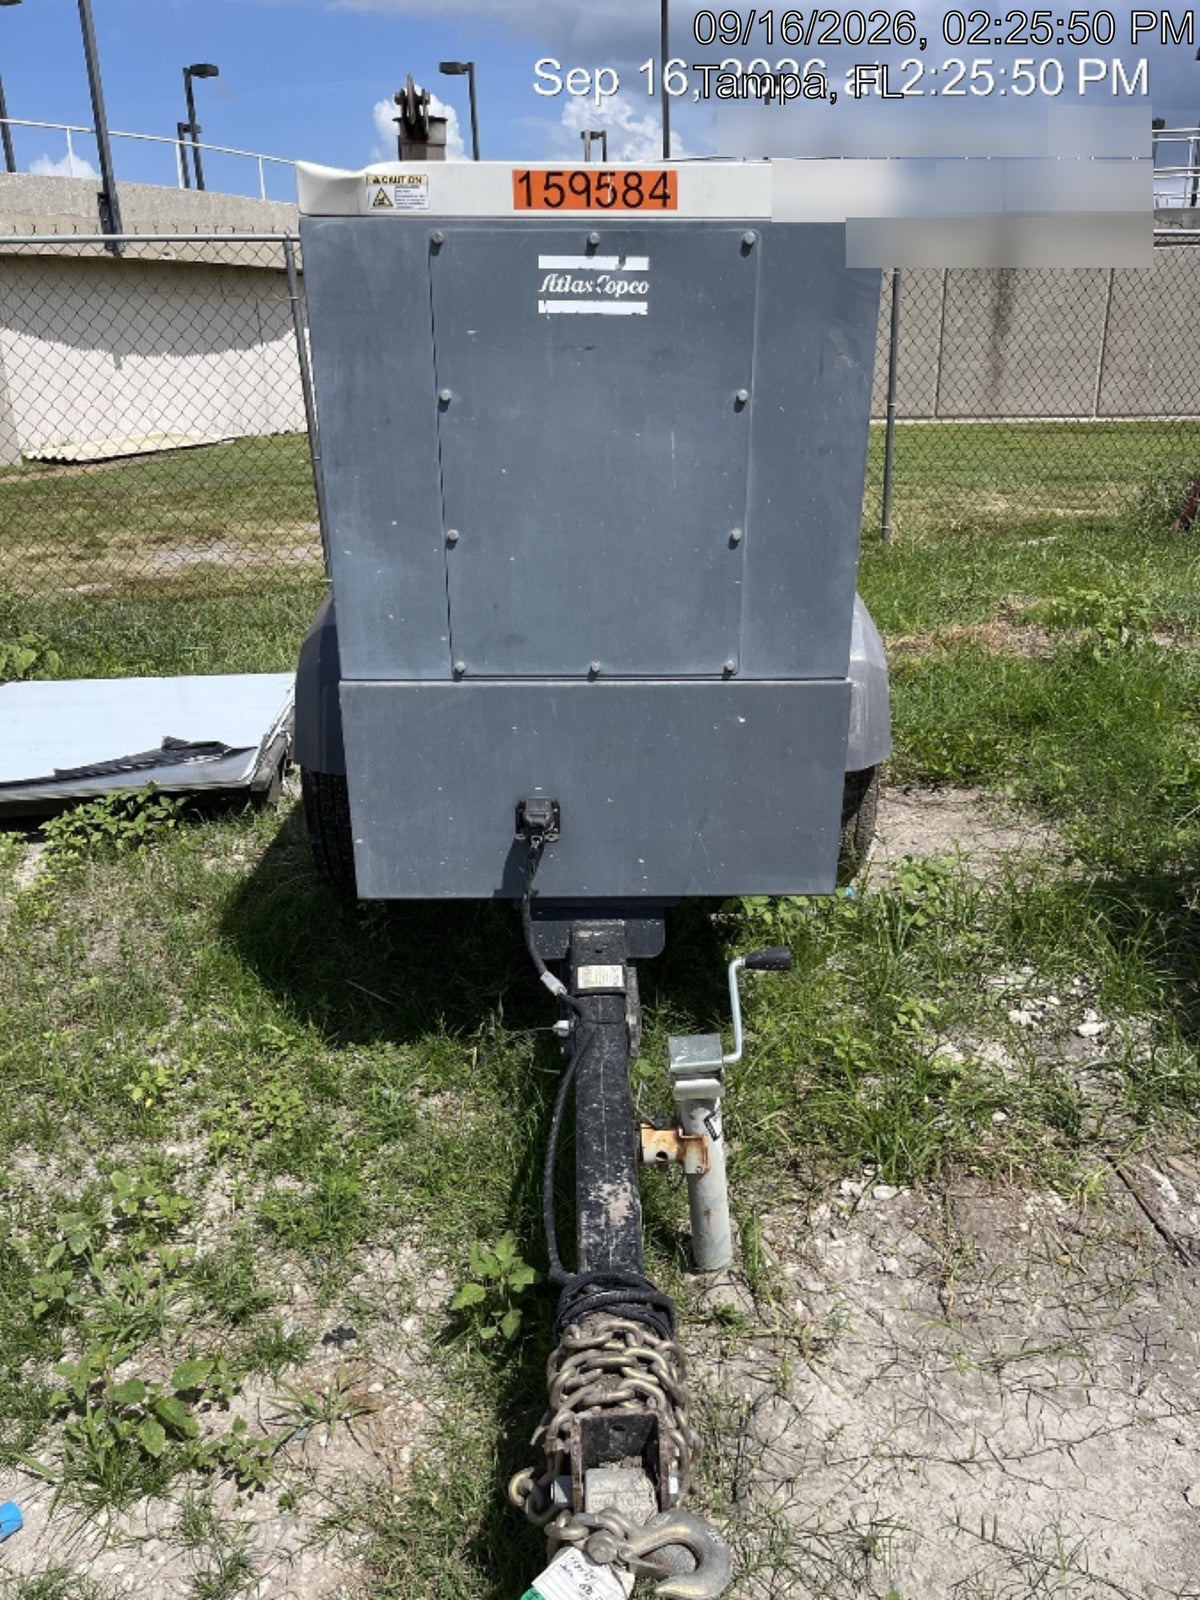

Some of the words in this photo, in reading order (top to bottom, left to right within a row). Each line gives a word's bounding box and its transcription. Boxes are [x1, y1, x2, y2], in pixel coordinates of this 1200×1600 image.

[381, 175, 422, 184] CAUTON
[517, 171, 672, 209] 159584
[537, 273, 593, 294] Atlas
[595, 274, 650, 298] Copco
